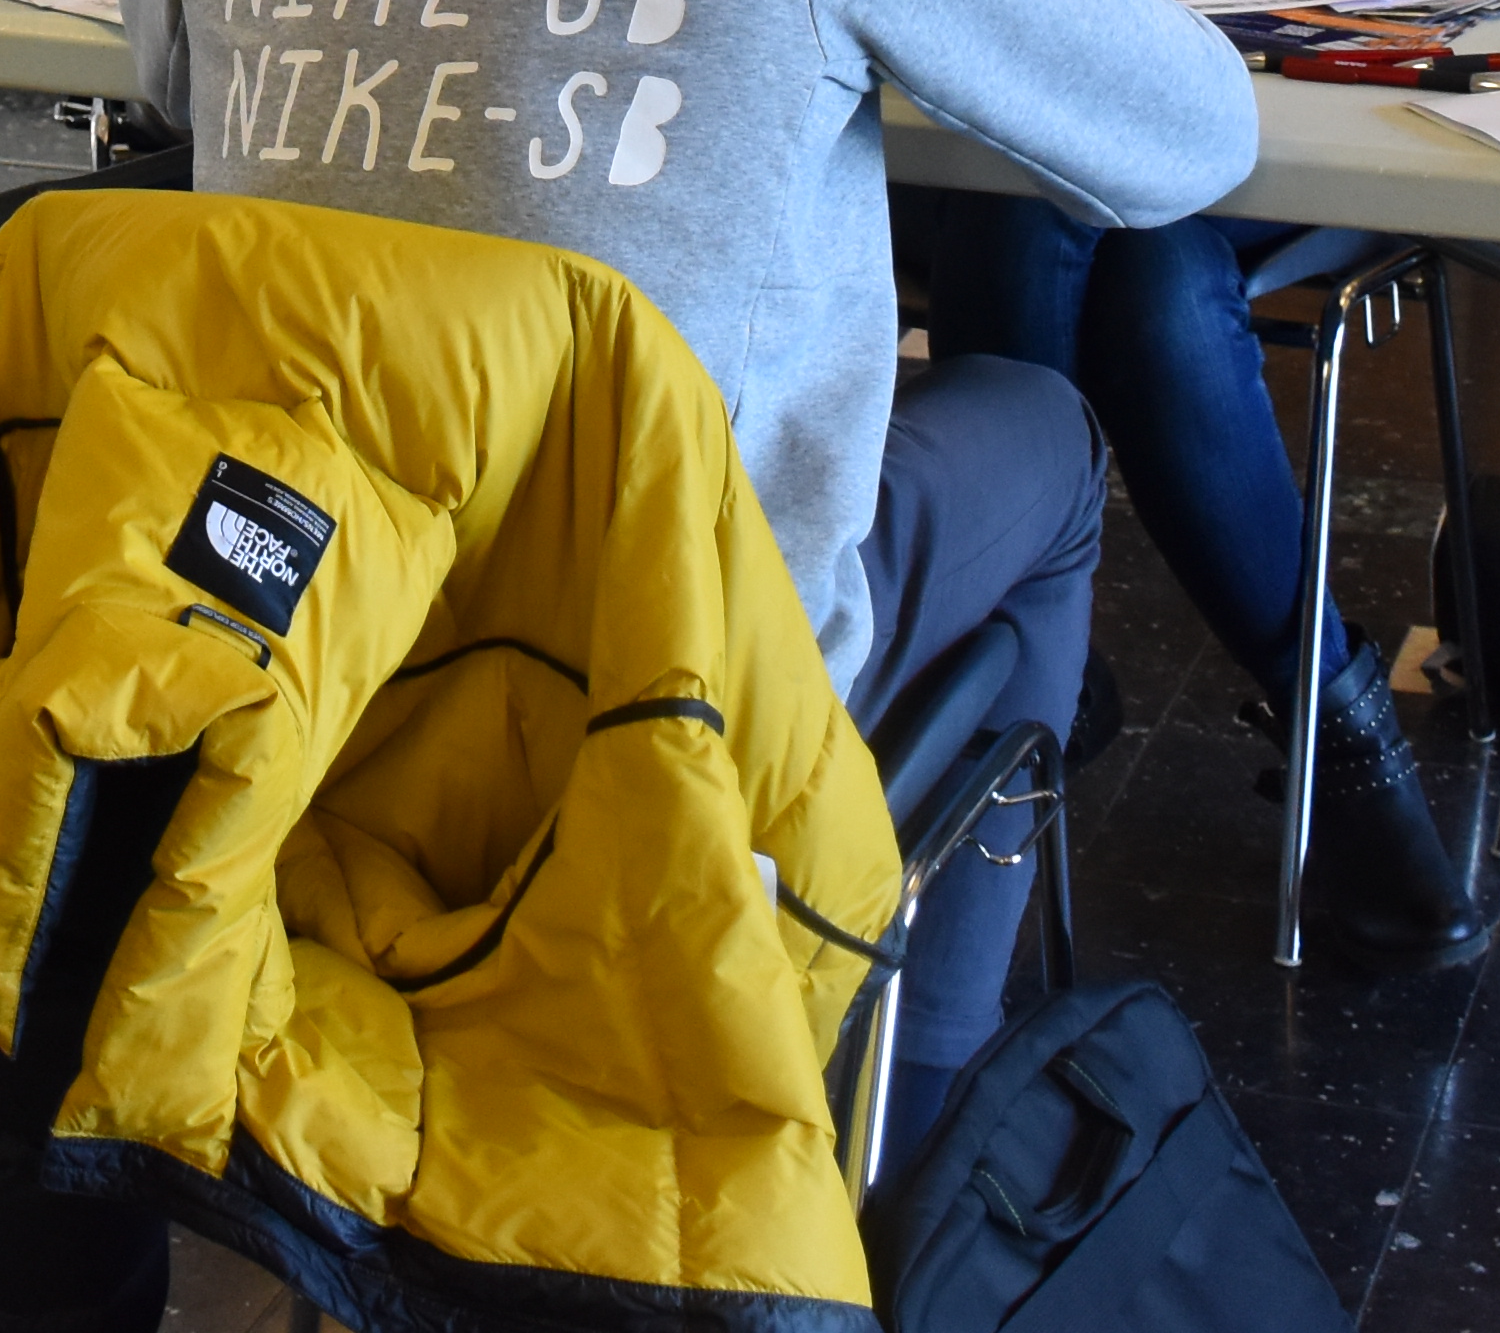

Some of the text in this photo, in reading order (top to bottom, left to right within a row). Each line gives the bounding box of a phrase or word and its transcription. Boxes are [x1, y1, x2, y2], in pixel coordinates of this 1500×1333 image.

[222, 44, 682, 186] NIKE-SB
[235, 533, 300, 587] NORTH
[242, 519, 293, 561] FACE
[229, 548, 267, 584] THE
